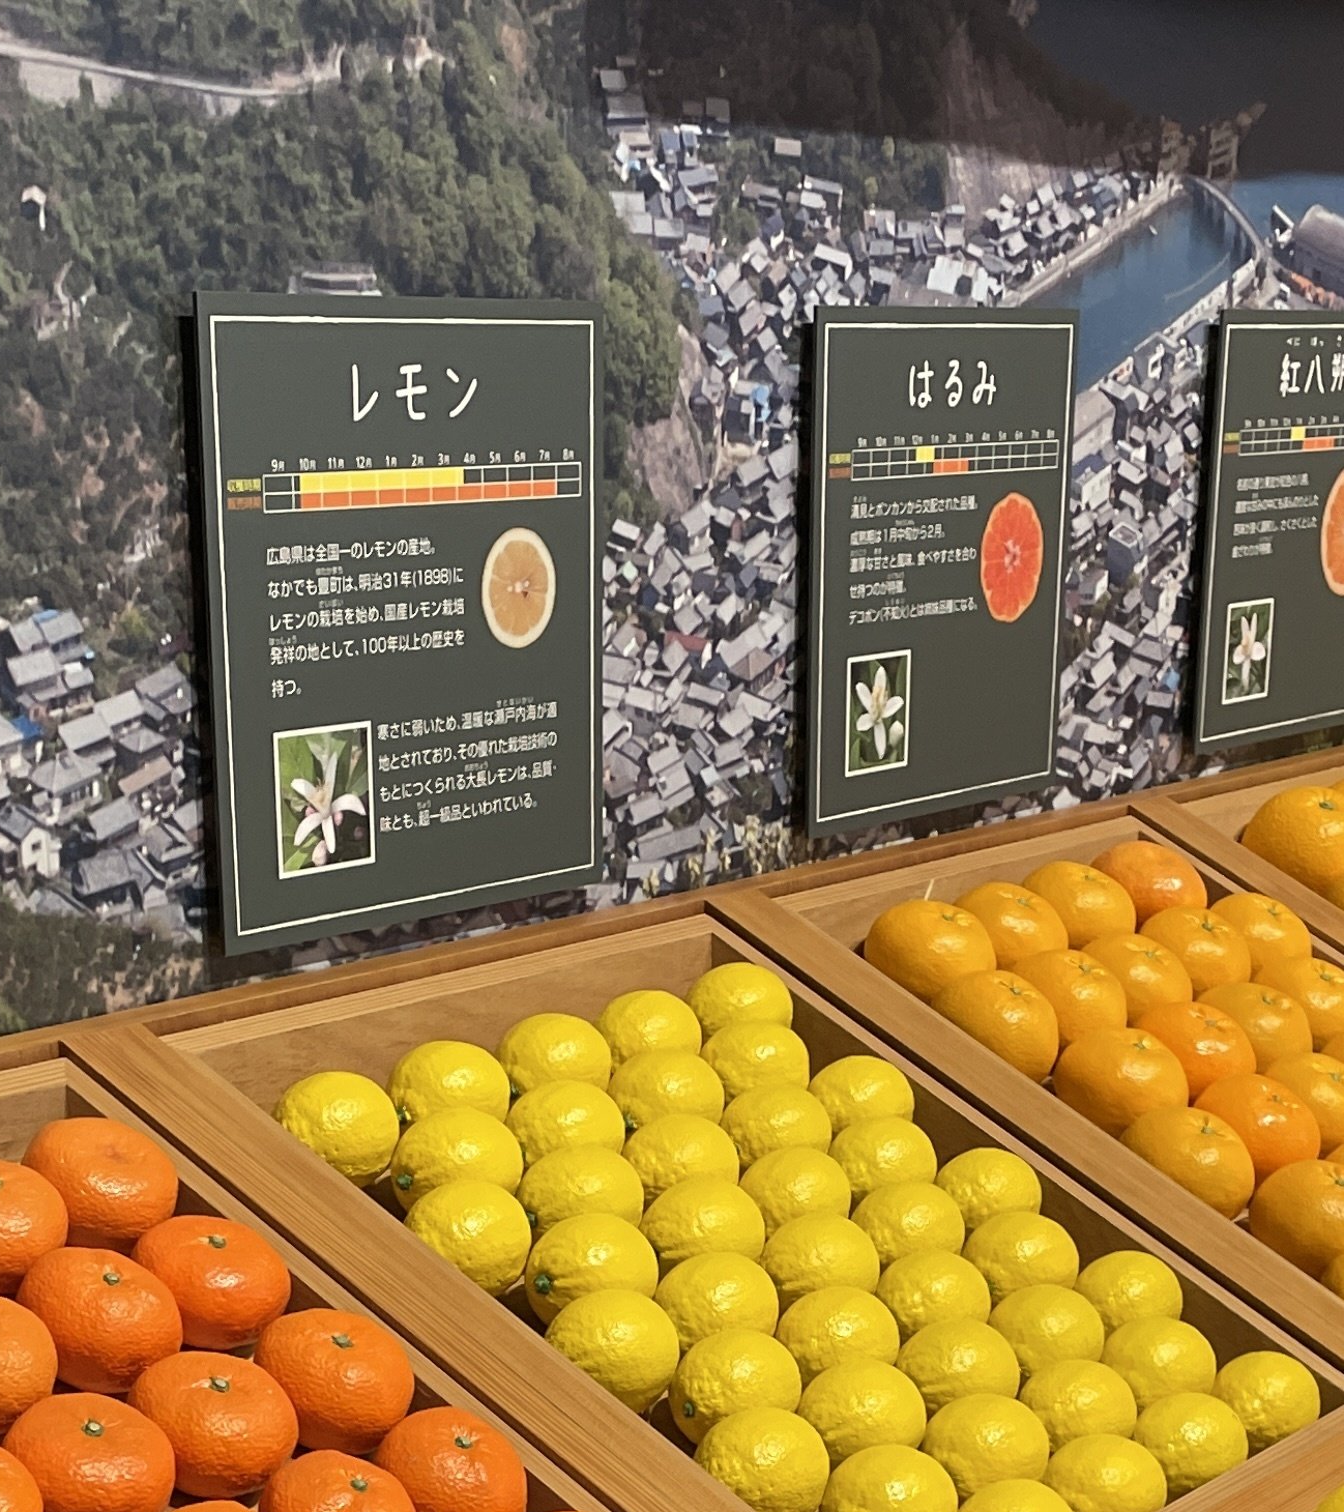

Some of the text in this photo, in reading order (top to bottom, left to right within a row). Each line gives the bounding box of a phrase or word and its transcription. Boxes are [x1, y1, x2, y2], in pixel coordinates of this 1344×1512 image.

[351, 362, 478, 422] レモン
[908, 359, 997, 408] はるみ
[271, 679, 302, 699] 持つ。
